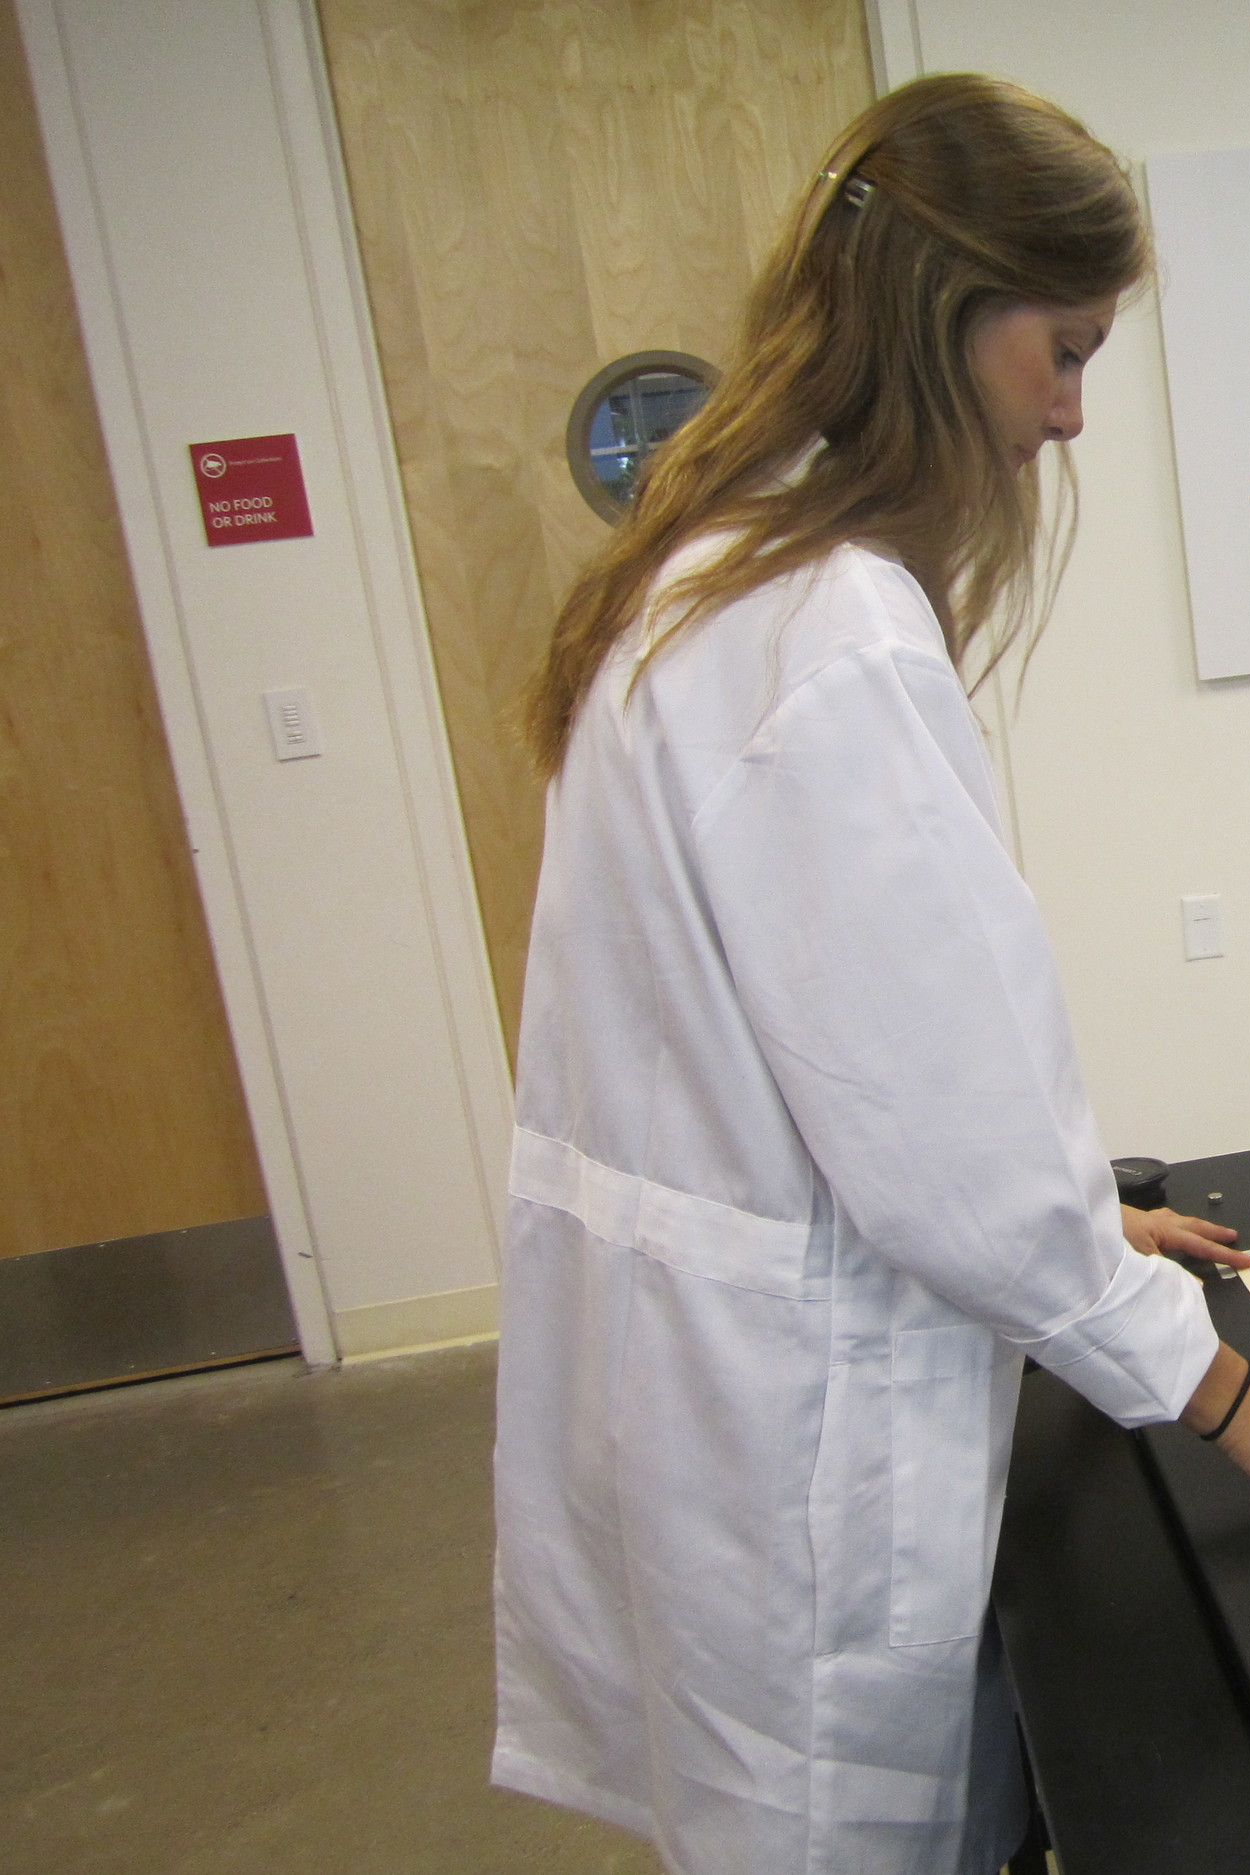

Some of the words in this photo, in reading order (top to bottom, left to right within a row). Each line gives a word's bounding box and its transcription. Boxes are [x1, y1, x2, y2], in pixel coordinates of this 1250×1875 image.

[210, 501, 231, 512] NO
[234, 497, 273, 510] FOOD
[213, 517, 233, 528] OR
[235, 512, 277, 526] DRINK
